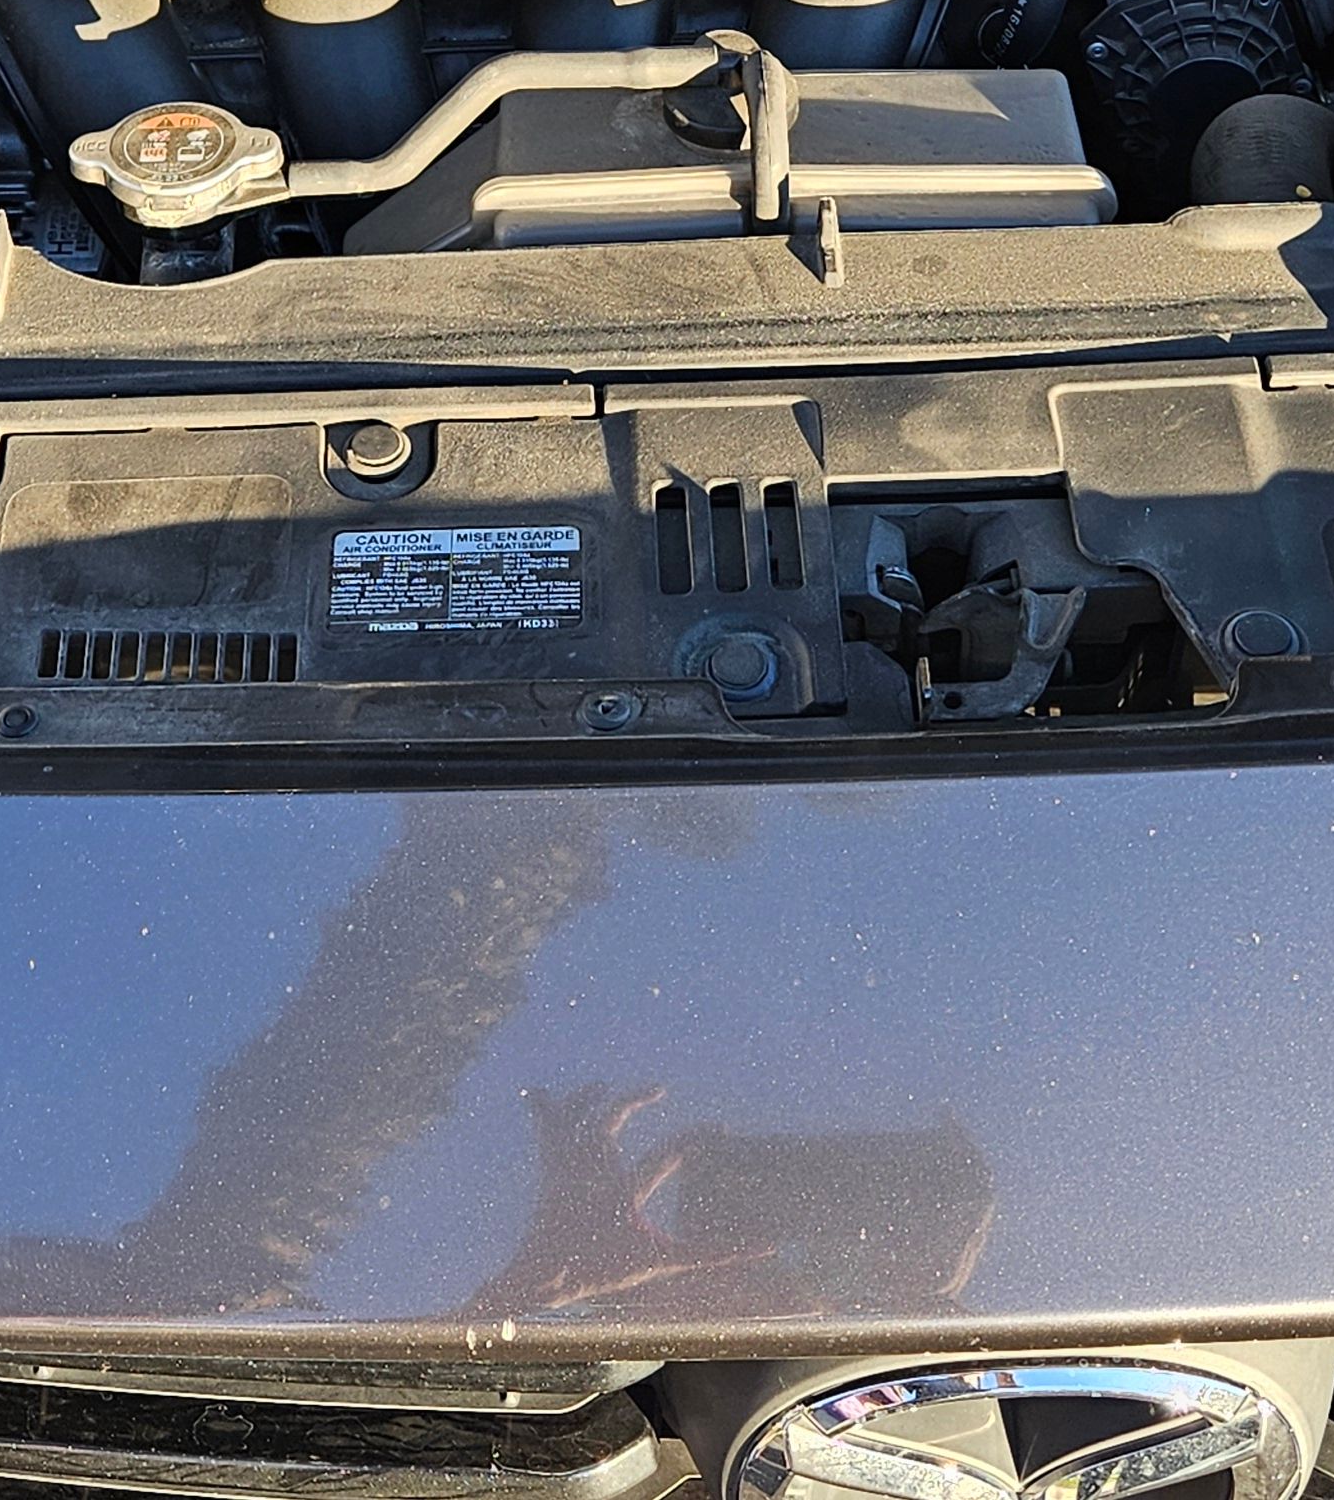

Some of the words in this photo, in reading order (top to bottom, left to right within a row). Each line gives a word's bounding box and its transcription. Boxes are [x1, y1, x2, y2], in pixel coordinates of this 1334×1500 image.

[355, 533, 432, 545] CAUTION
[456, 532, 493, 543] MISE
[496, 531, 518, 541] EN
[520, 528, 575, 541] GARDE
[342, 546, 362, 554] AIR
[364, 544, 442, 553] CONDITIONER
[476, 541, 552, 551] CLIMATISEUR
[368, 621, 419, 632] mazda
